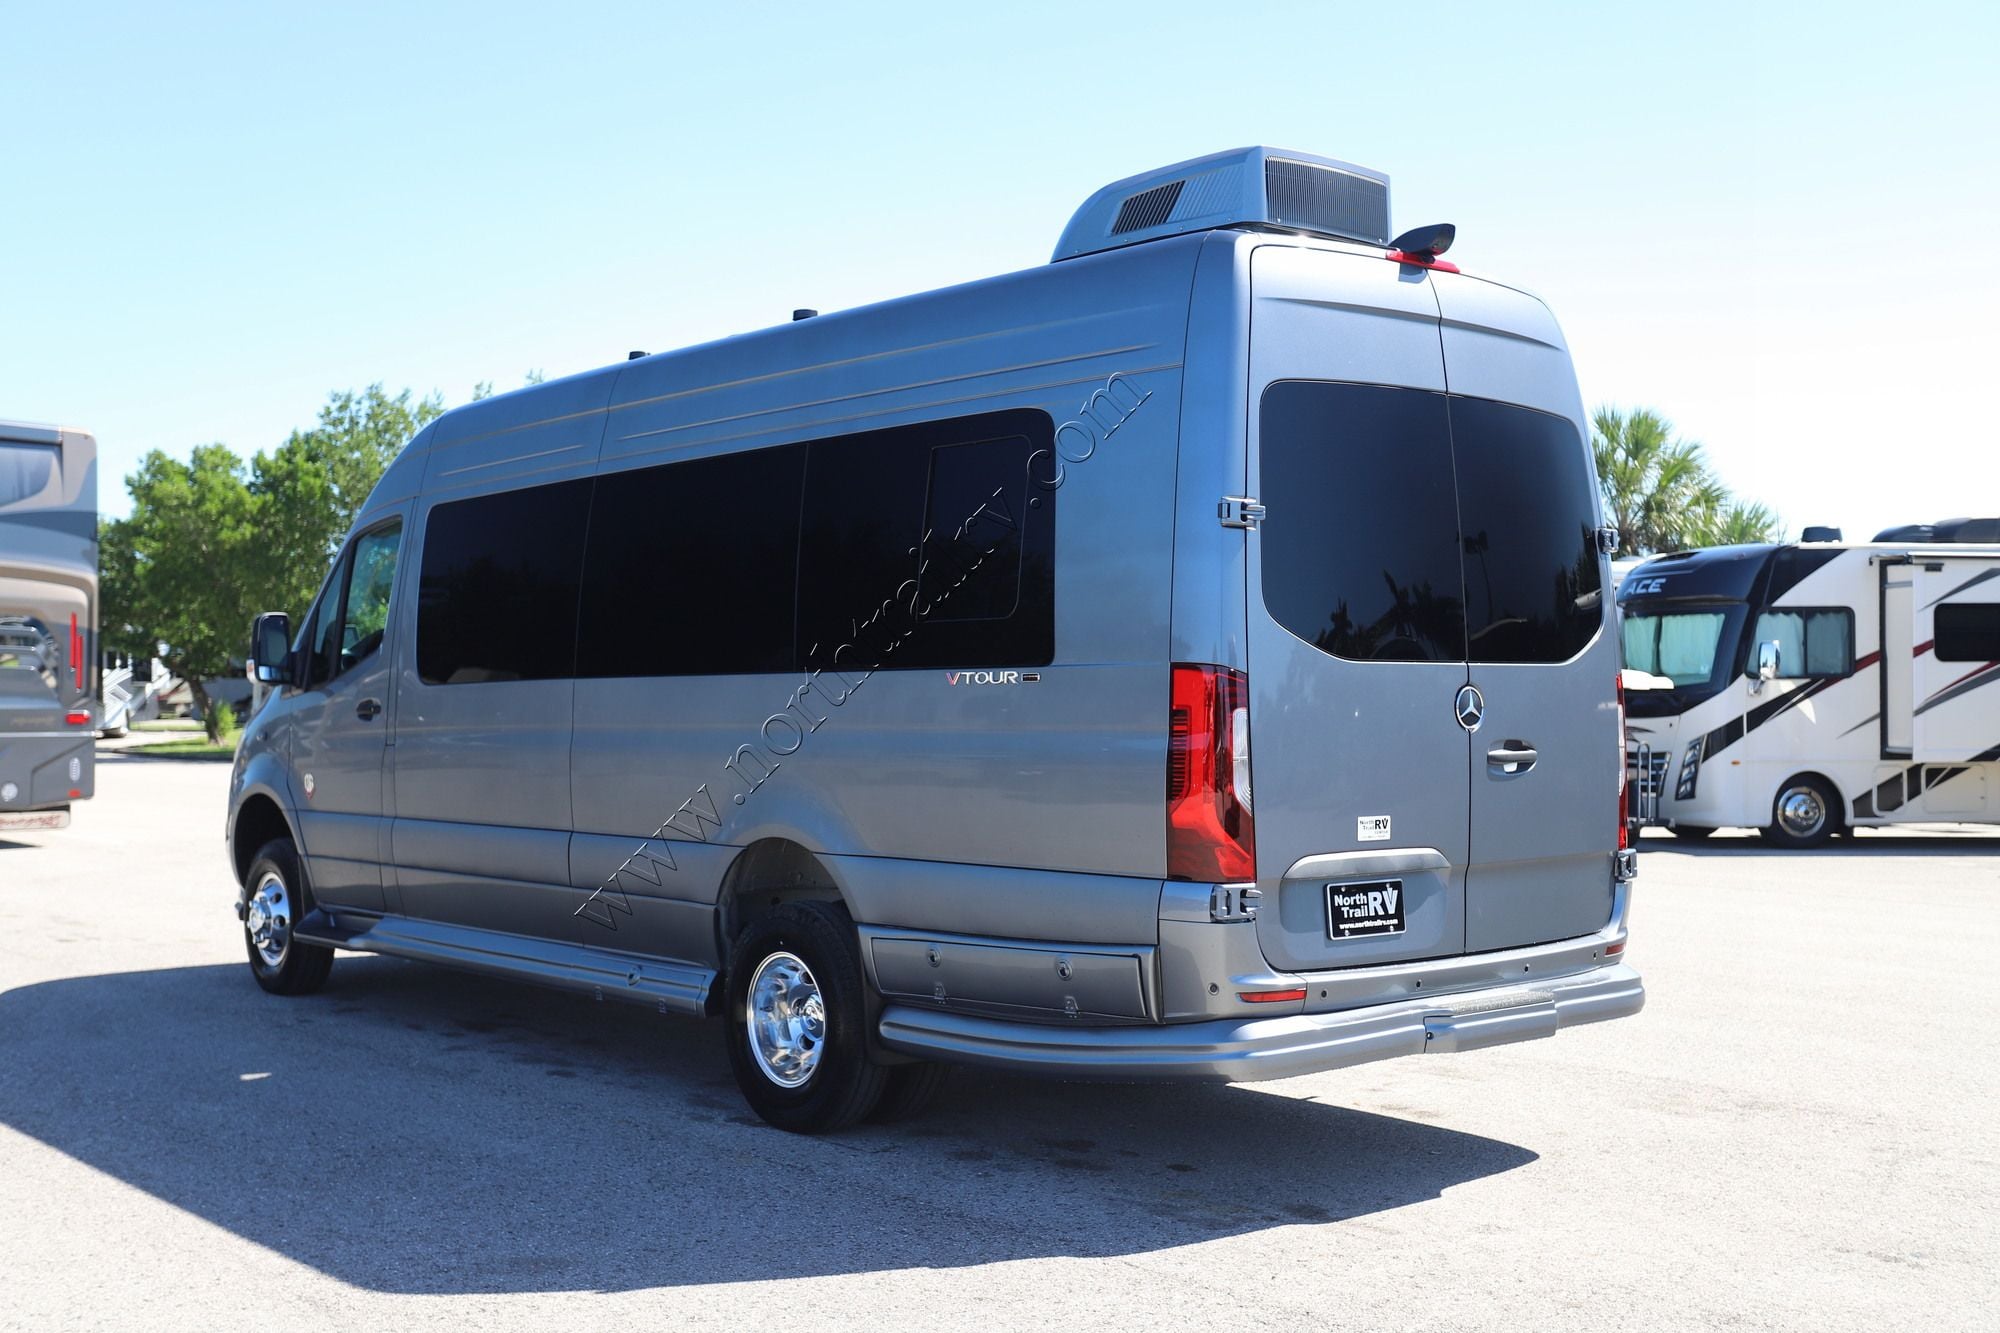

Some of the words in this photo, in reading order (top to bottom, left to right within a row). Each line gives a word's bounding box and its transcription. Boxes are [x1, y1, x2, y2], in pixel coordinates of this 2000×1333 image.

[1624, 578, 1666, 596] ACE
[946, 671, 1019, 686] VTOUR
[1374, 817, 1389, 830] RV
[1334, 893, 1367, 906] North
[1367, 887, 1398, 916] RV
[1341, 905, 1368, 918] Trail
